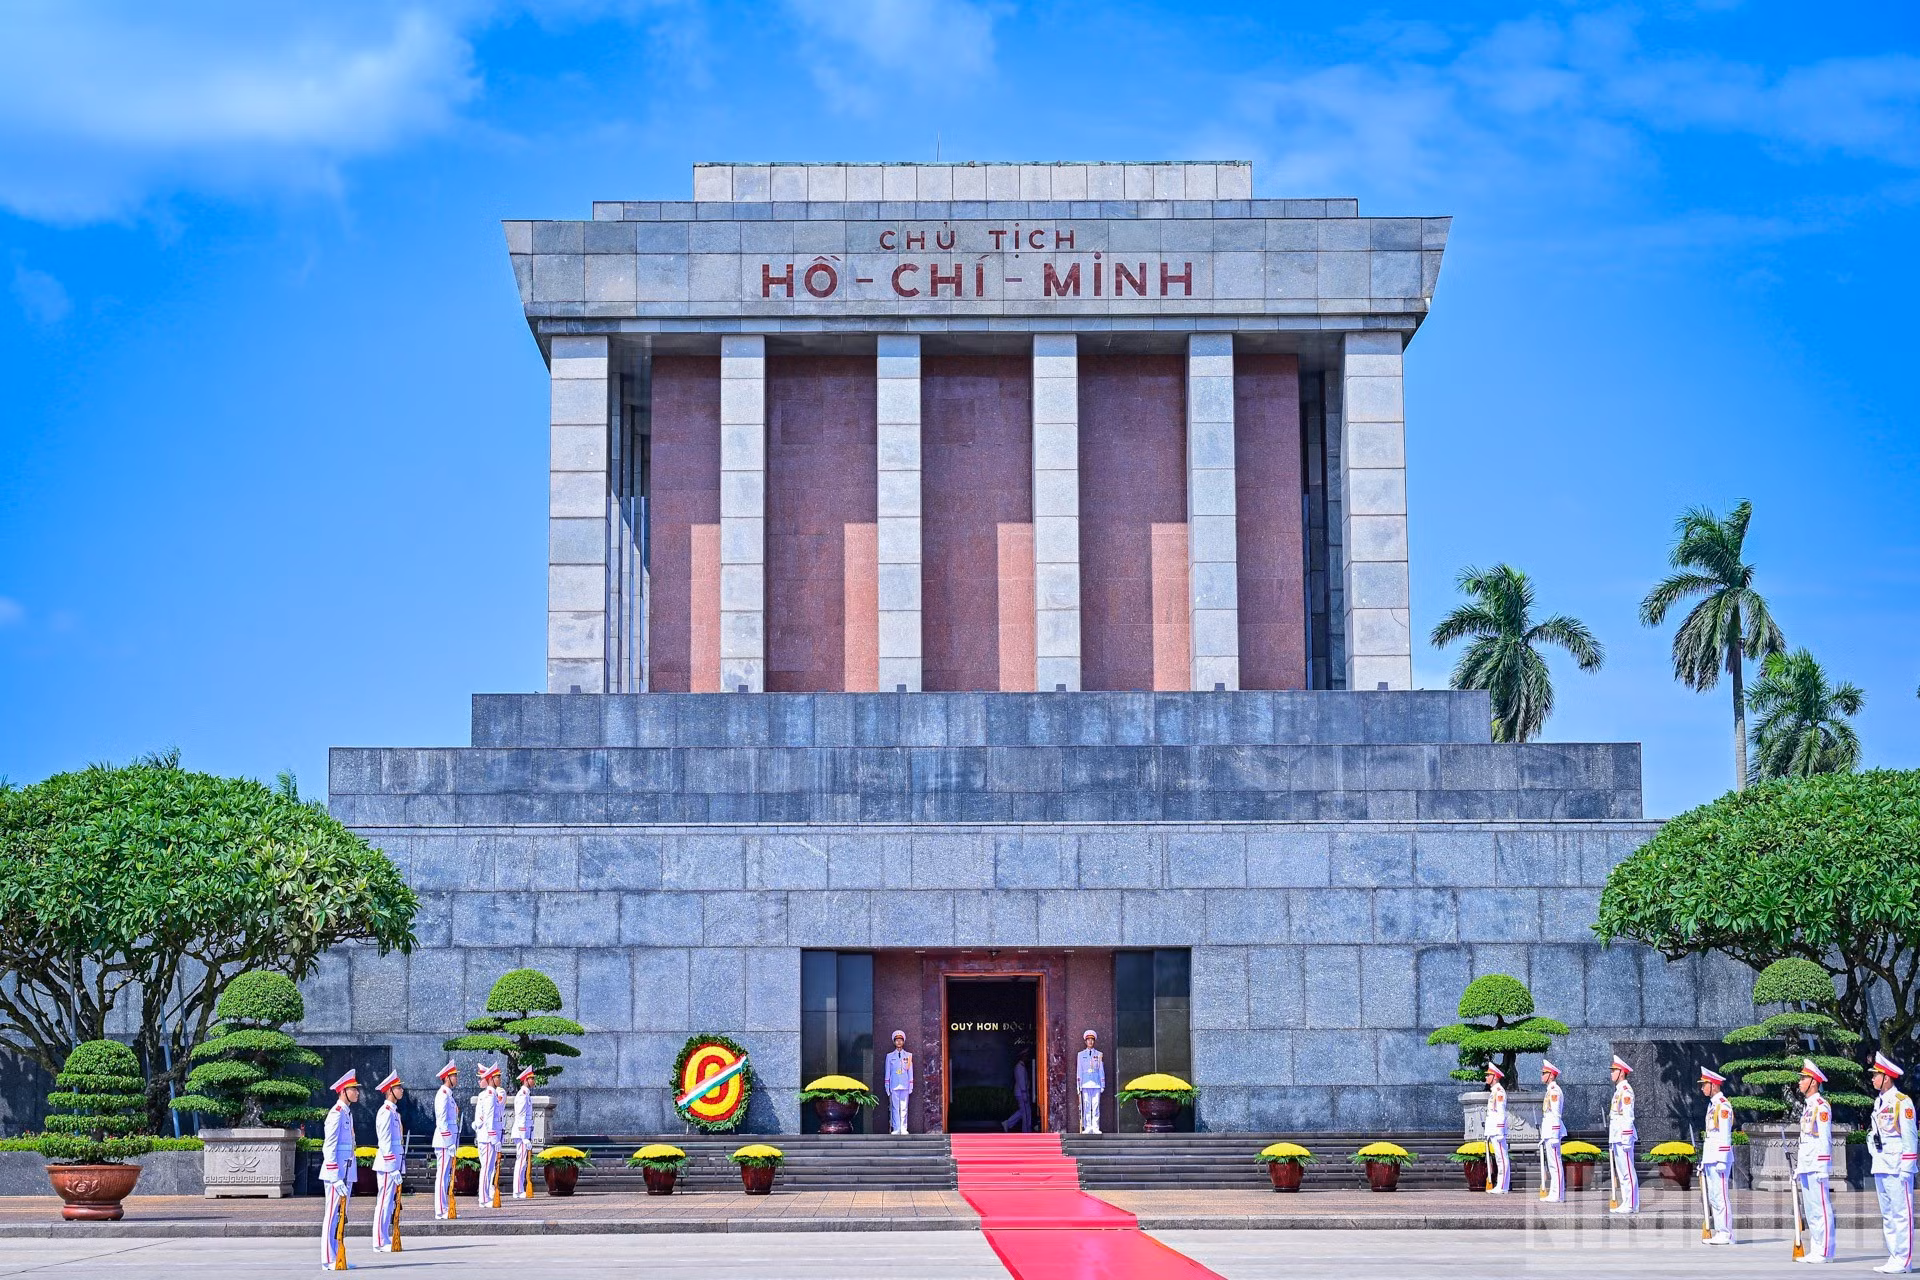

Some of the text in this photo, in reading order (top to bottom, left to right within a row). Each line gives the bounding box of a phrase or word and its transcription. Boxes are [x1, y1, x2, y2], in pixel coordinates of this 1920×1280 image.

[879, 222, 1075, 259] CHỦ TỊCH
[761, 255, 842, 298] HỒ
[891, 253, 990, 298] CHÍ
[1043, 251, 1193, 297] MINH
[976, 1022, 998, 1031] HƠN
